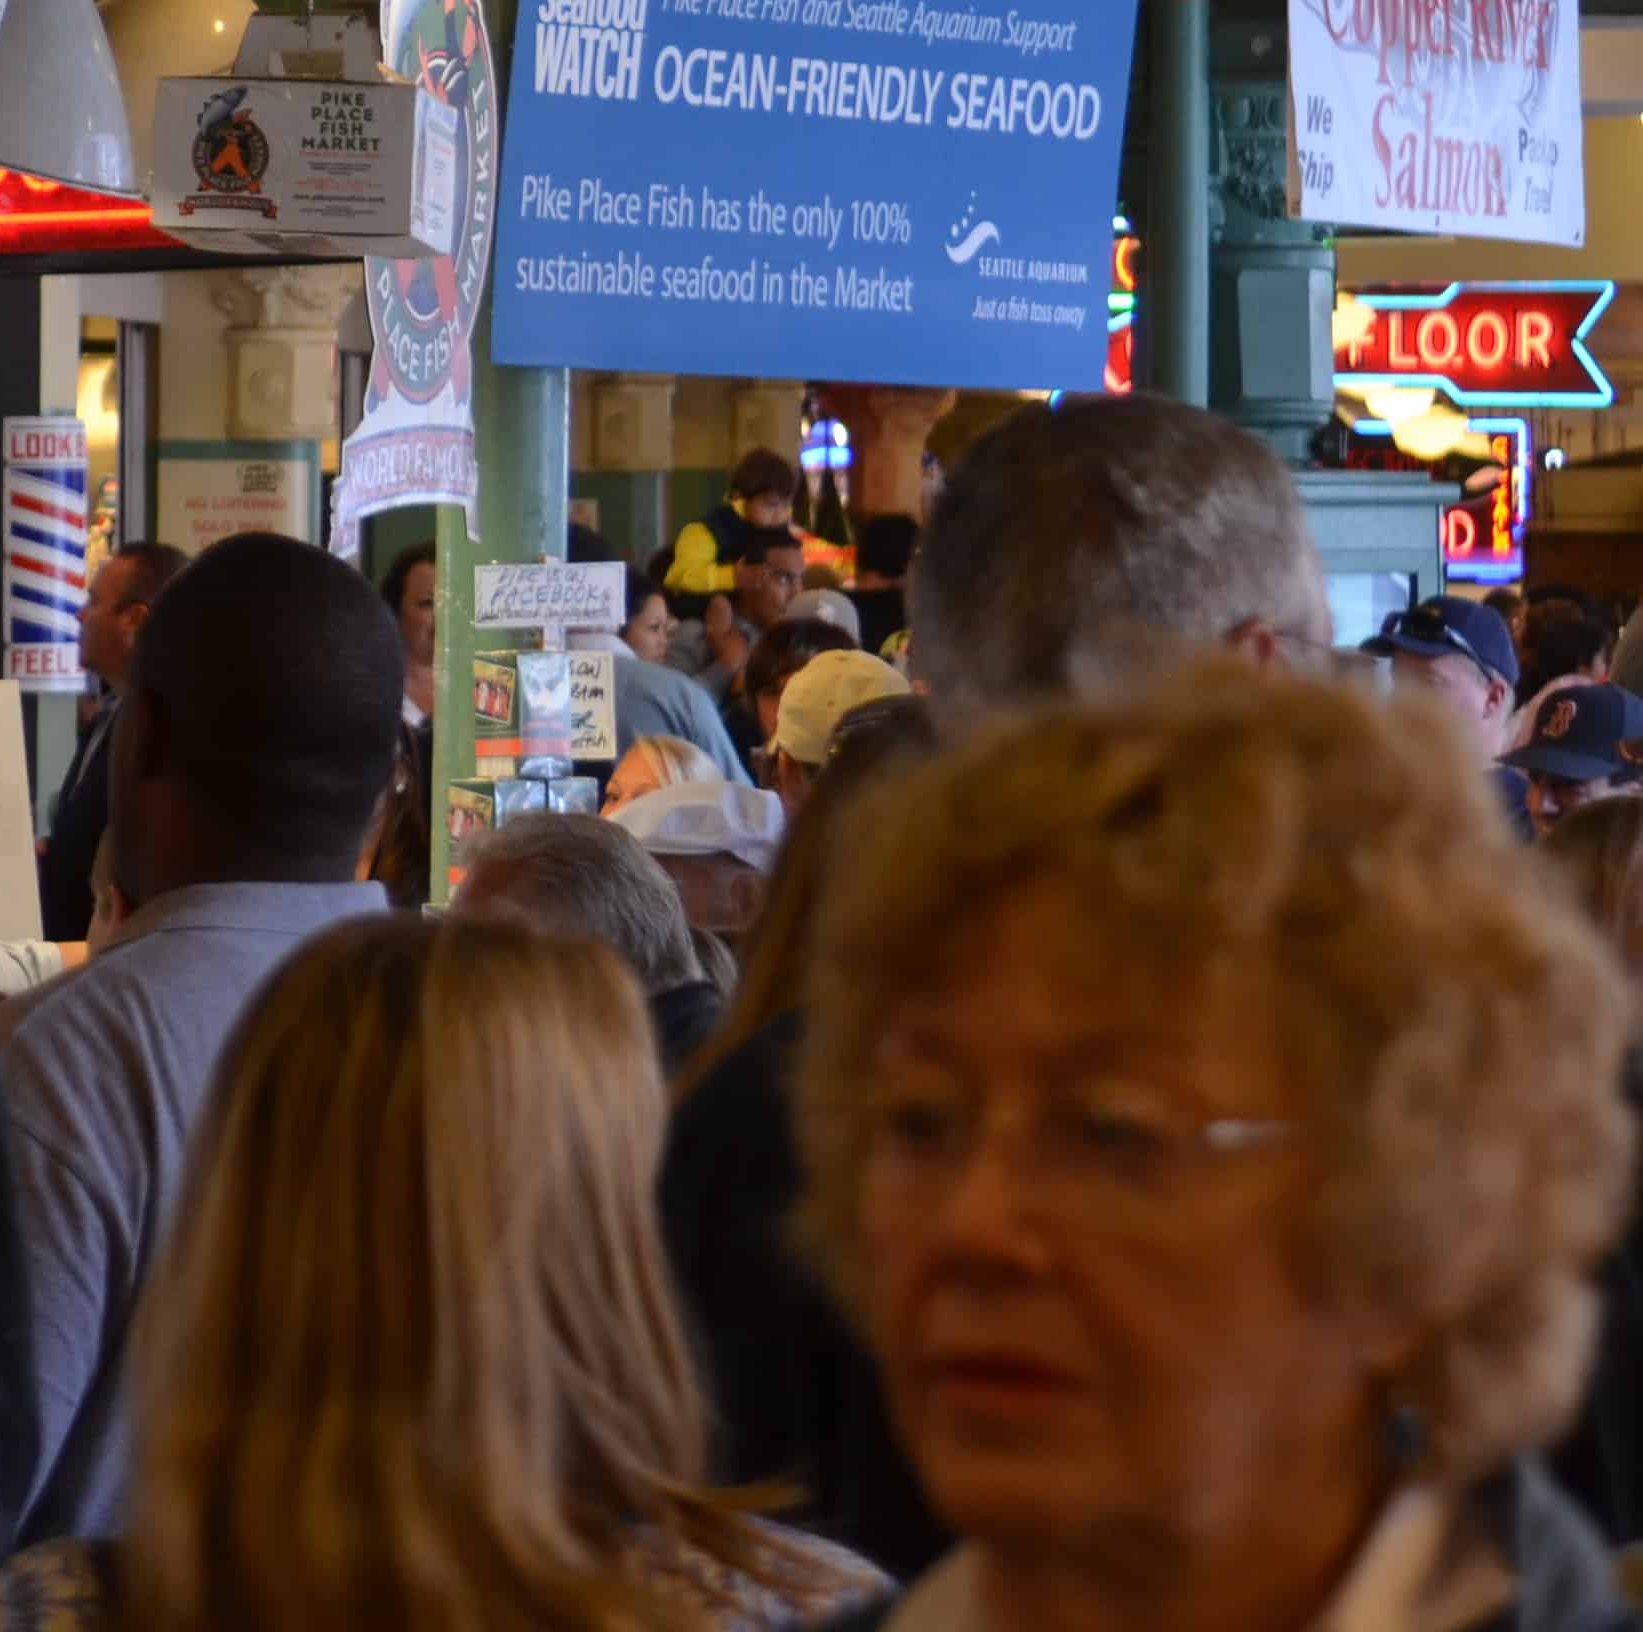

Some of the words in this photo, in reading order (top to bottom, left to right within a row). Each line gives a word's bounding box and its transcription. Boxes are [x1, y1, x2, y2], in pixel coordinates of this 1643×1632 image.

[910, 0, 1001, 46] Aquarium
[1003, 11, 1077, 56] Support
[535, 24, 642, 100] WATCH
[321, 91, 366, 106] PIKE
[653, 44, 944, 125] OCEAN-FRIENDLY
[947, 74, 1100, 141] SEAFOOD
[311, 107, 374, 122] PLACE
[1306, 95, 1333, 135] We
[319, 123, 364, 136] FISH
[301, 137, 382, 152] MARKET
[1371, 91, 1509, 218] Salmon
[520, 175, 571, 222] Pike
[578, 179, 641, 225] Place
[648, 184, 694, 228] Fish
[701, 185, 743, 231] has
[748, 189, 787, 234] the
[793, 192, 843, 250] only
[851, 199, 910, 244] 100%
[375, 264, 420, 382] PLACE
[423, 317, 461, 372] FISH
[461, 77, 491, 306] MARKET
[515, 251, 654, 298] sustainable
[660, 256, 755, 303] seafood
[762, 267, 776, 303] in
[778, 265, 829, 307] the
[833, 274, 914, 313] Market
[978, 256, 1026, 279] SEATTLE
[1027, 259, 1089, 284] AQUARIUM
[971, 296, 996, 319] Just
[997, 301, 1007, 318] a
[1008, 295, 1029, 320] fish
[10, 432, 70, 460] LOOK
[490, 582, 599, 608] FACEBOOK
[10, 648, 70, 676] FEEL
